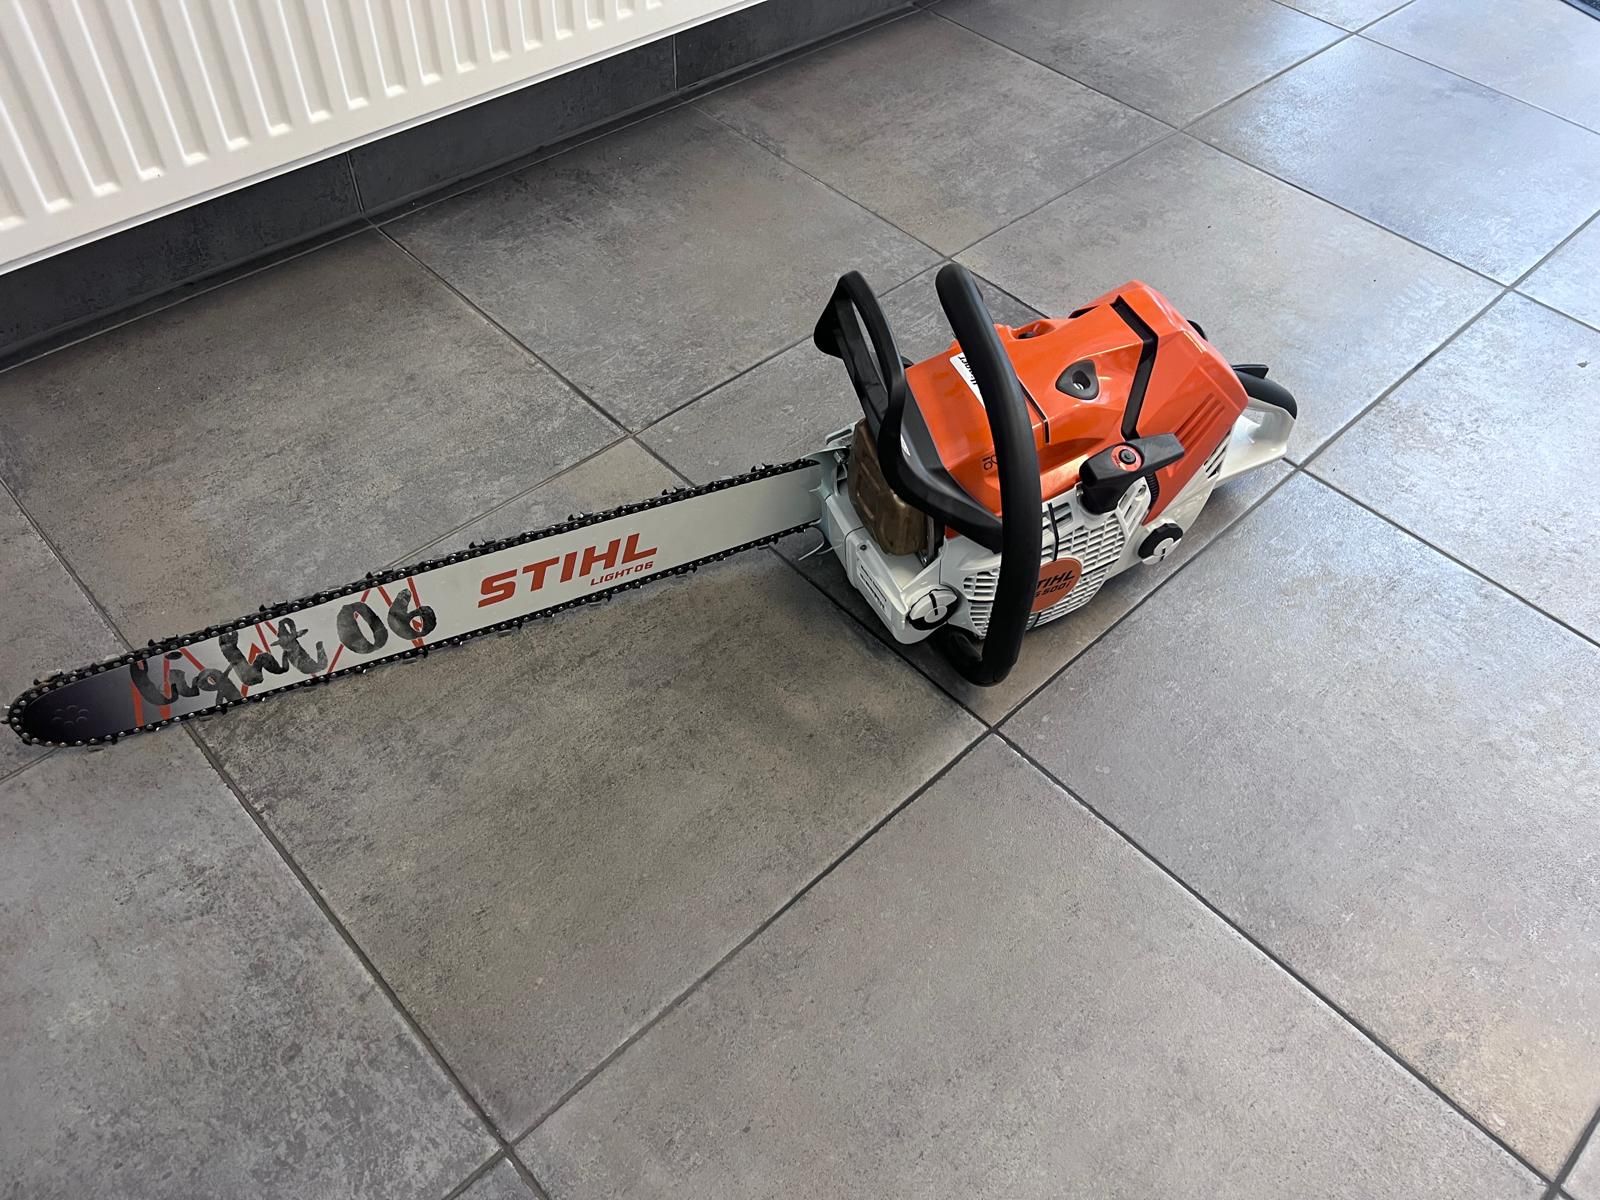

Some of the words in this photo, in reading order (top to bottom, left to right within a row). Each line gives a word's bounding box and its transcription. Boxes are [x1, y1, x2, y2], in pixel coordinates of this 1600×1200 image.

[478, 533, 657, 608] STIHL
[1037, 570, 1075, 590] TIHL
[336, 588, 437, 654] 06
